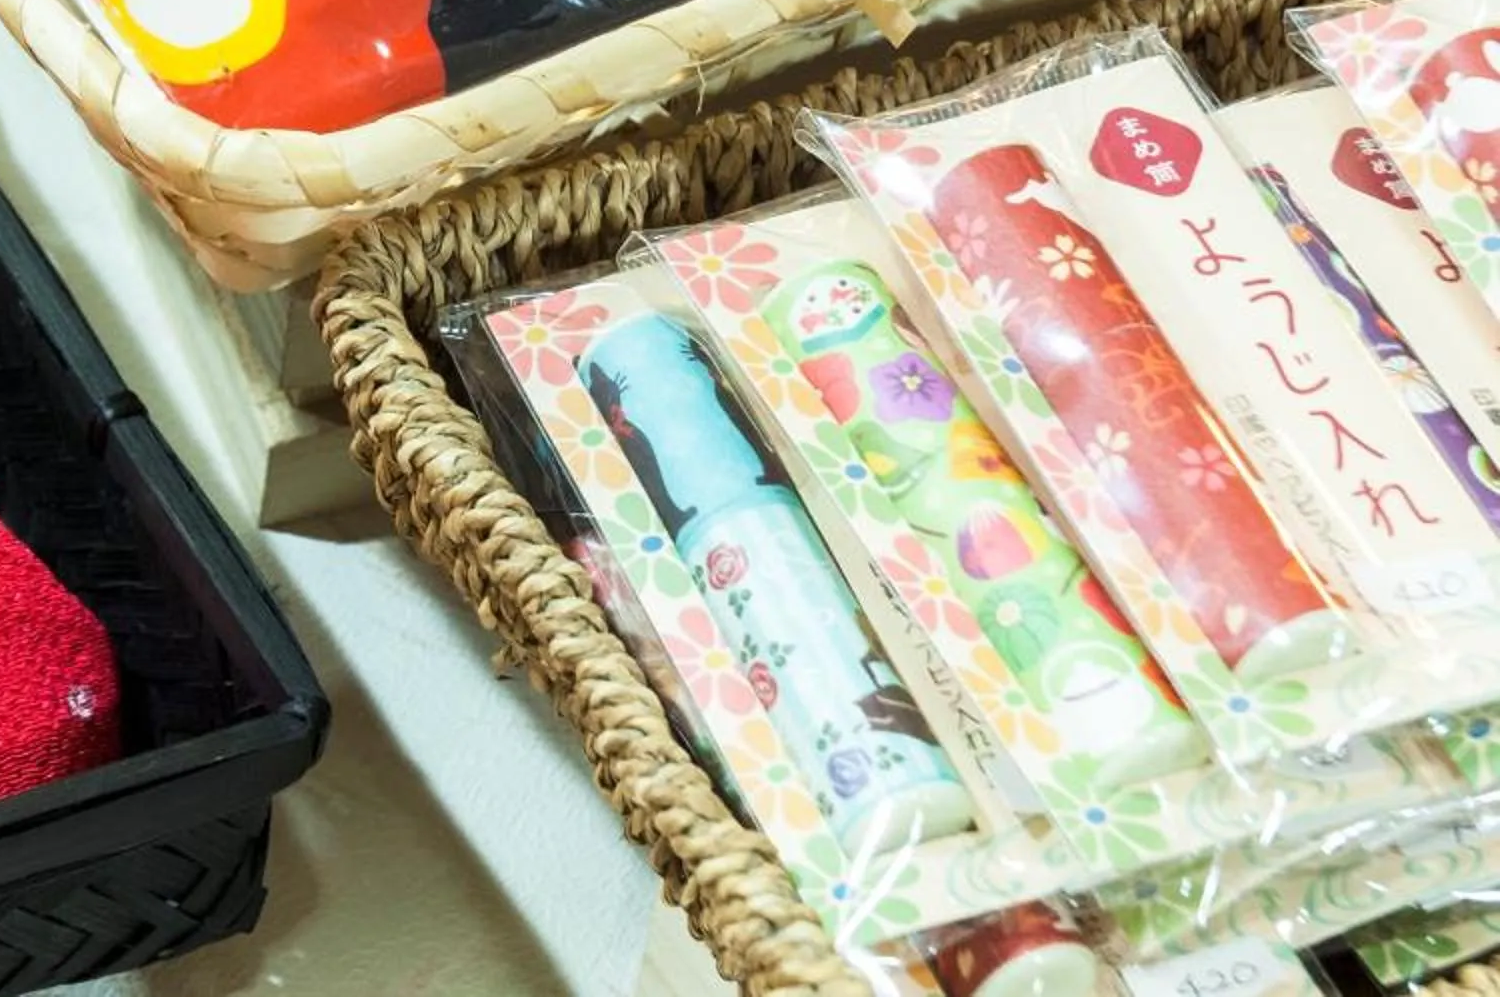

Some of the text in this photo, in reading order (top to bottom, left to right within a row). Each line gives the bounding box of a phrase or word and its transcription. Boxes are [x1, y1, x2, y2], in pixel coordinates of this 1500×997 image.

[1181, 217, 1441, 538] ようじ入れ
